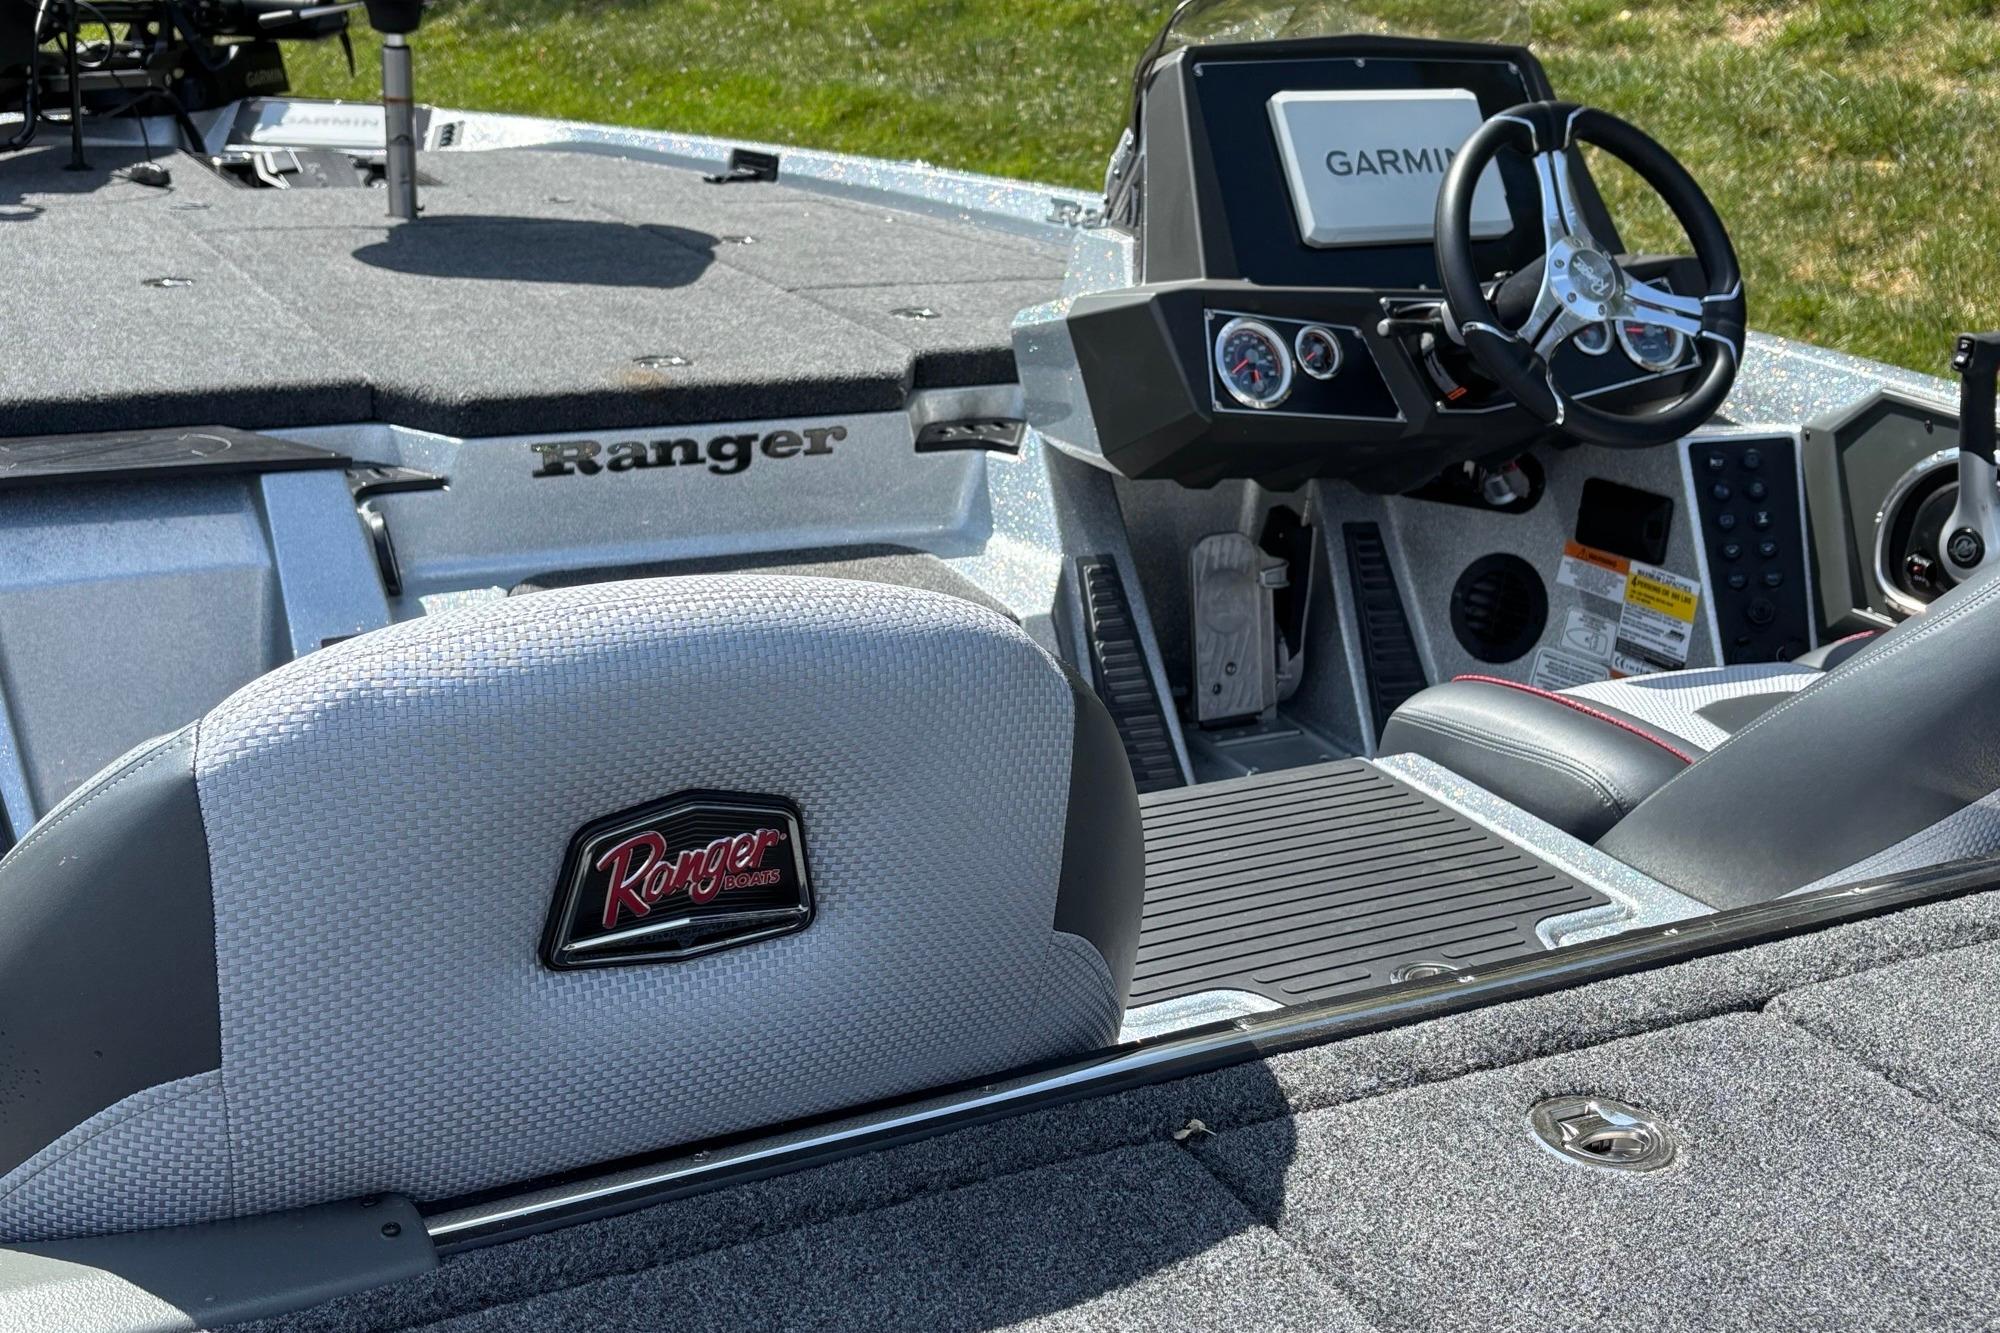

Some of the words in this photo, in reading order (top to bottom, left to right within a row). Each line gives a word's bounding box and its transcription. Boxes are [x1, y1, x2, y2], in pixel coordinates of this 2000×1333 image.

[531, 425, 847, 478] Ranger
[596, 828, 780, 929] Ranger
[724, 868, 781, 891] BOATS
